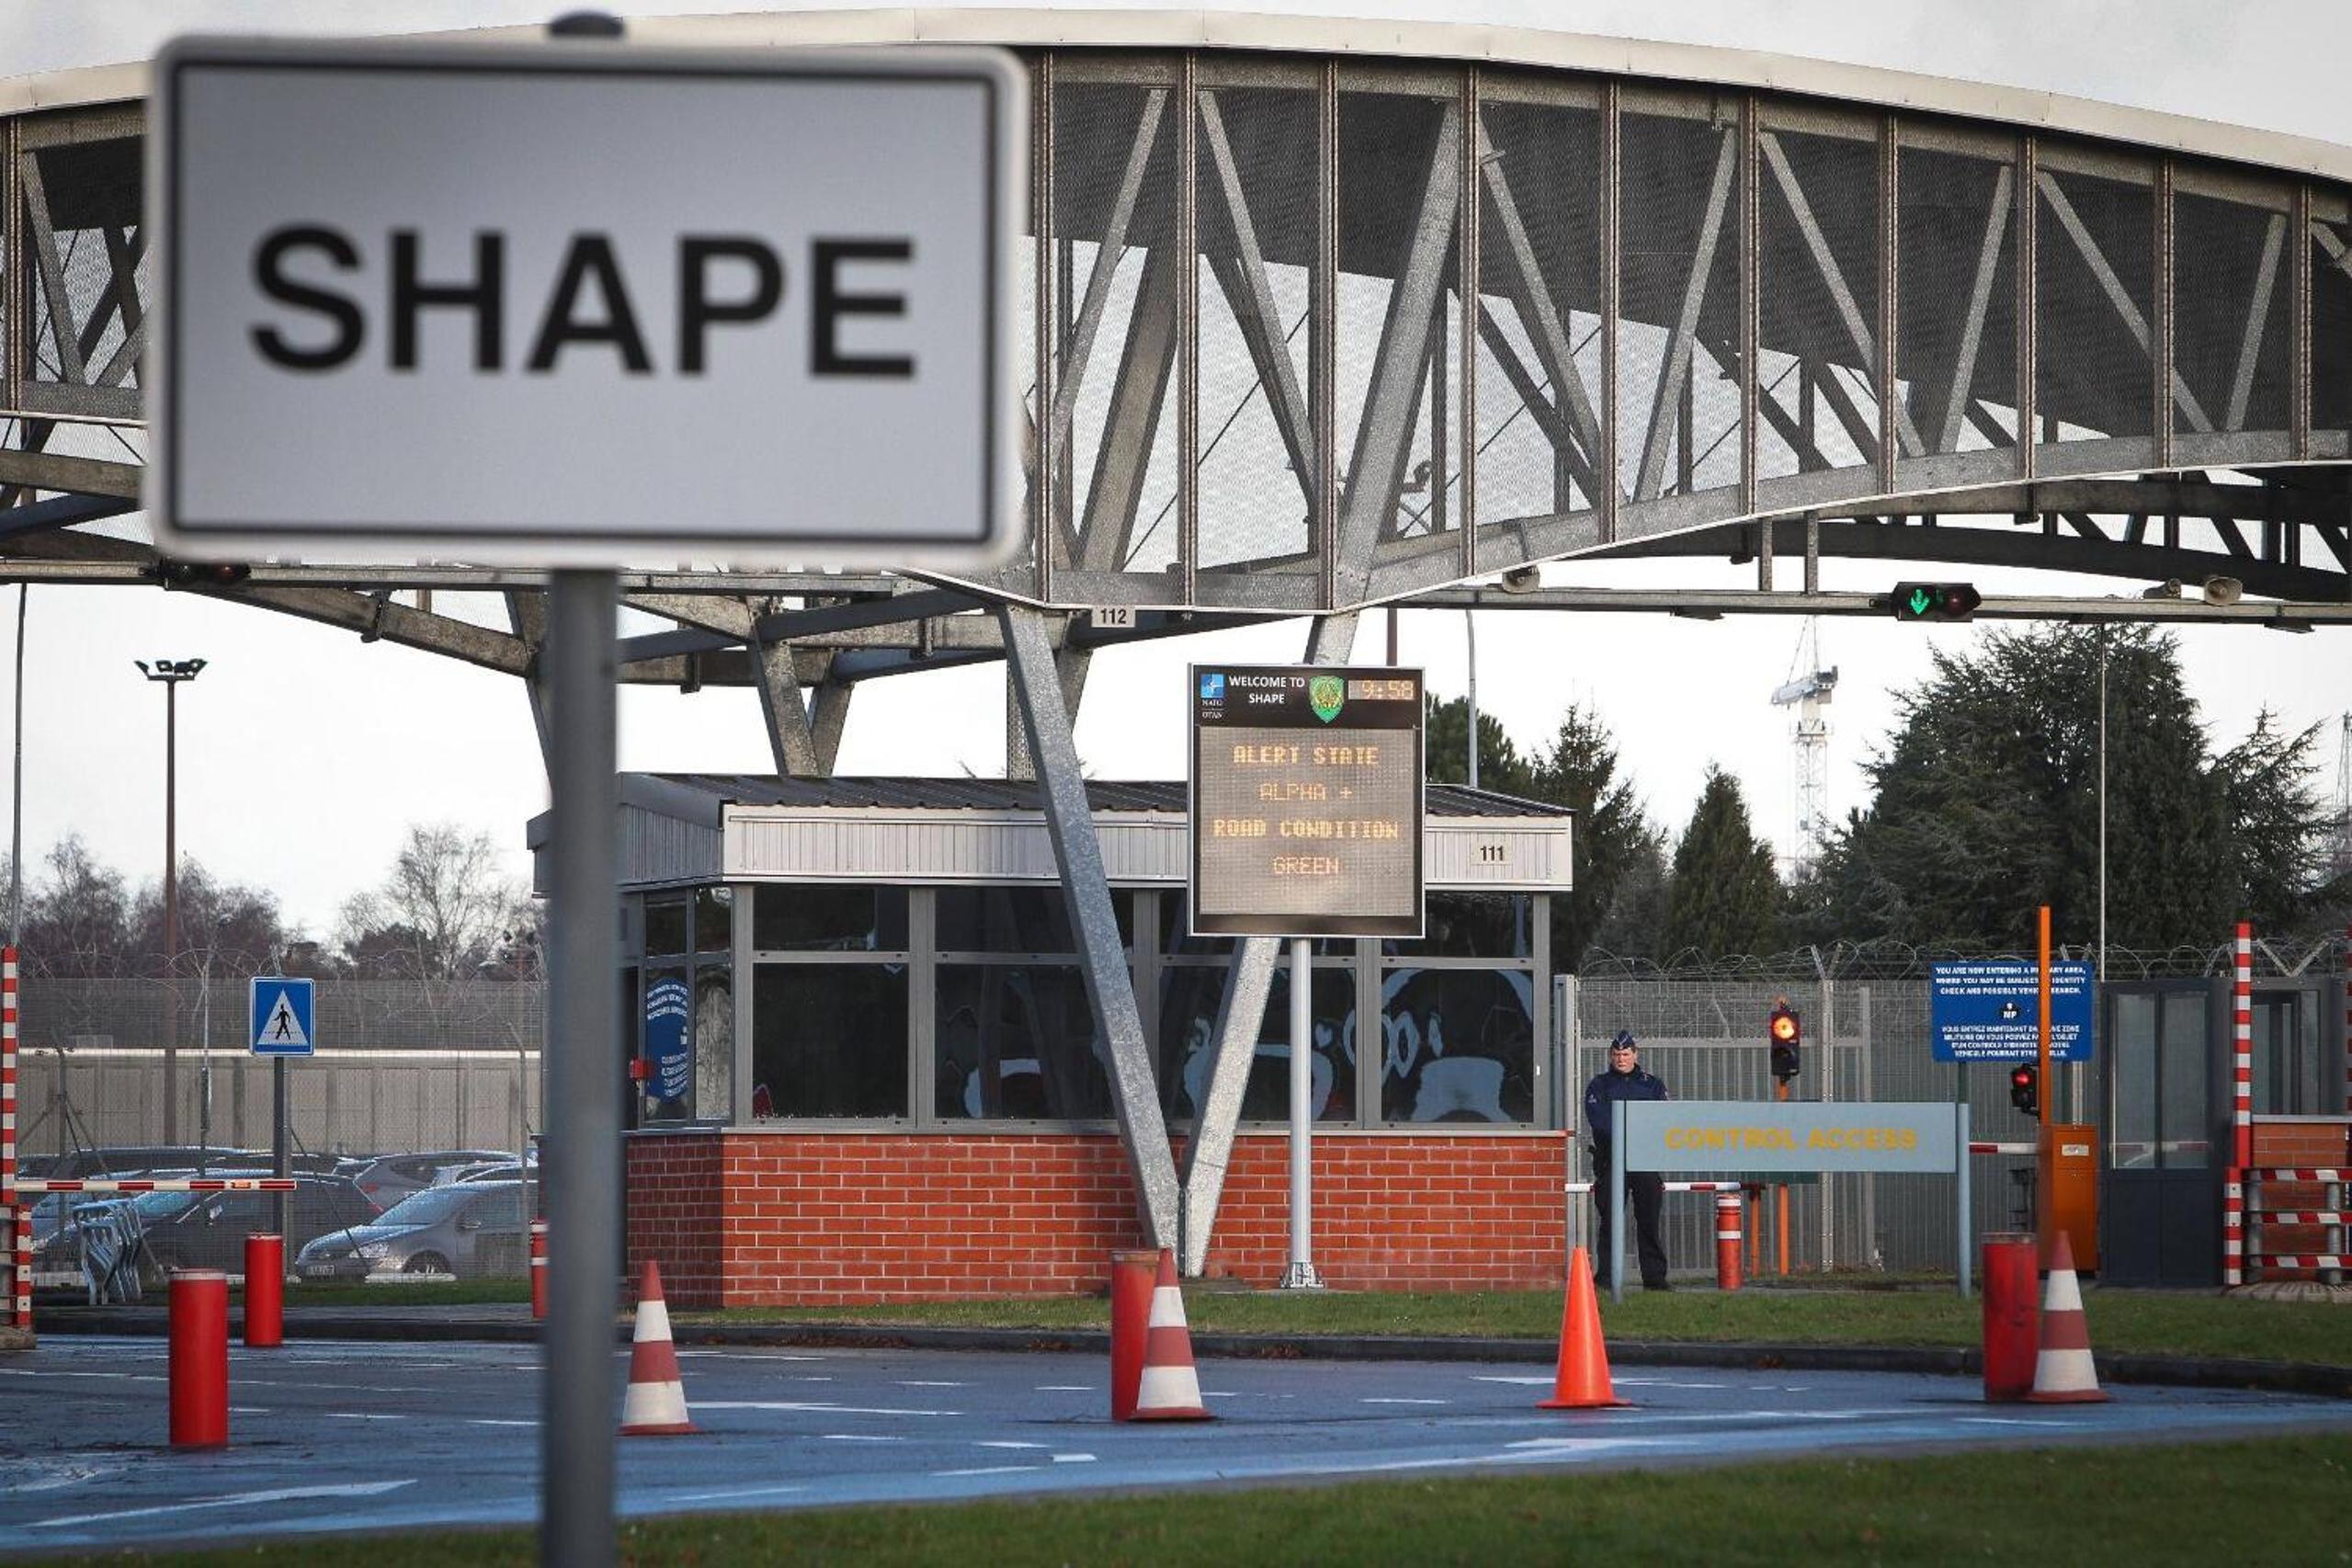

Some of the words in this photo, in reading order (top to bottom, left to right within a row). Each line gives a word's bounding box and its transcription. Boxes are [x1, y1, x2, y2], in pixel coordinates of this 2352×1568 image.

[249, 222, 916, 379] SHAPE
[1100, 608, 1127, 624] 112
[1228, 676, 1287, 688] WELCOME
[1290, 676, 1305, 688] TO
[1248, 692, 1286, 705] SHAPE
[1233, 744, 1301, 764] ALERT
[1312, 746, 1379, 765] STATE
[1259, 783, 1326, 801] ALPHA
[1212, 819, 1267, 837] ROAD
[1279, 820, 1399, 838] CONDITION
[1480, 846, 1504, 861] 111
[1273, 857, 1340, 874] GREEN
[1936, 966, 1951, 974] YOU
[1952, 966, 1967, 974] ARE
[1967, 966, 1985, 974] NOW
[1986, 966, 2022, 974] ENTERING
[2023, 966, 2029, 974] A
[2004, 1010, 2017, 1018] MP
[1665, 1127, 1799, 1151] CONTROL
[1806, 1127, 1918, 1151] ACCESS
